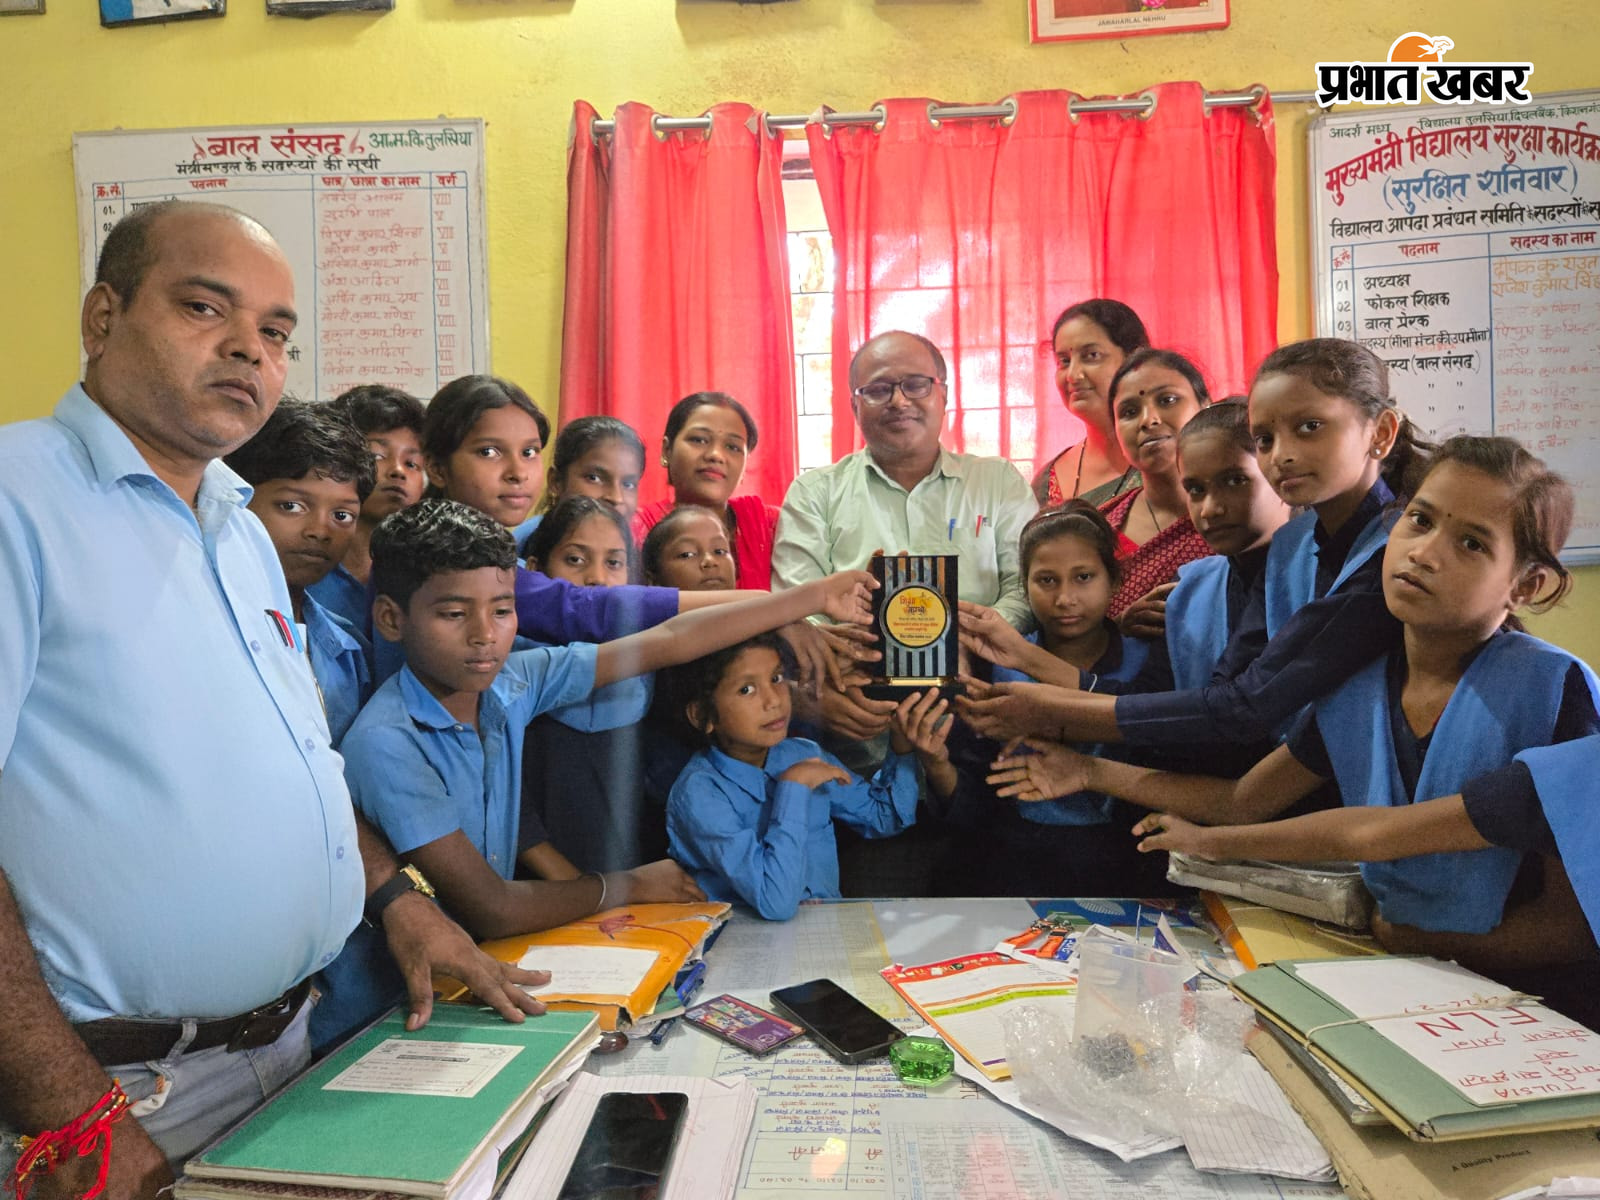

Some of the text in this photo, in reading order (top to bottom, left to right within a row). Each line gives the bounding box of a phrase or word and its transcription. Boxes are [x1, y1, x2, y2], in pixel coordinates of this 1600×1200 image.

[1329, 125, 1362, 139] आदर्श
[1366, 122, 1391, 134] मध्य
[1417, 117, 1461, 131] विद्यालय
[207, 128, 346, 158] बाल संसद
[243, 157, 258, 172] के
[324, 154, 342, 171] की
[348, 153, 381, 173] सूची
[1325, 132, 1404, 206] मुख्यमंत्री
[1405, 126, 1491, 163] विद्यालय
[1493, 125, 1547, 164] सुरक्षा
[380, 175, 396, 187] का
[398, 175, 422, 187] नाम
[436, 171, 458, 187] वर्ग
[1383, 160, 1578, 215] (सुरक्षित शनिवार)
[1329, 218, 1383, 239] विद्यालय
[1385, 216, 1428, 234] आपदा
[1432, 208, 1477, 230] प्रबंधन
[1480, 203, 1525, 225] समिति
[1534, 197, 1582, 223] सदस्यों
[1509, 231, 1597, 250] सदस्य का नाम
[1398, 242, 1440, 258] पदनाम
[1336, 281, 1349, 292] 01
[1363, 273, 1411, 290] अध्यक्ष
[1336, 301, 1351, 313] 02
[1365, 290, 1450, 311] फोकल शिक्षक
[1396, 312, 1430, 330] प्रेरक
[1415, 1006, 1541, 1037] FLN
[1494, 1082, 1584, 1099] TULSIA
[1494, 1149, 1531, 1160] Product
